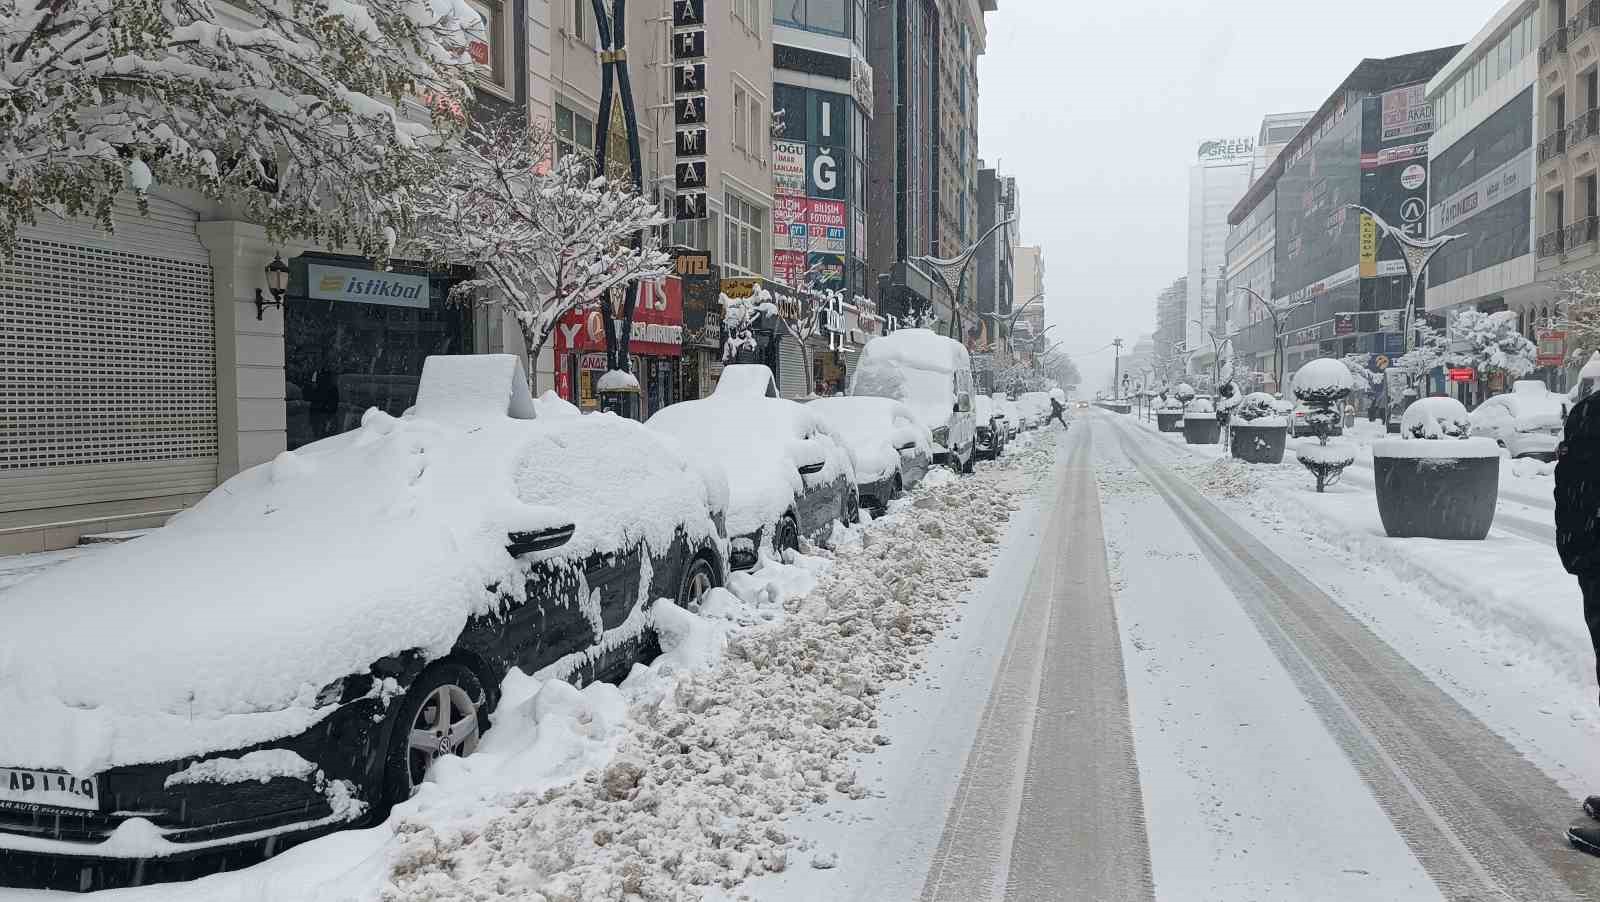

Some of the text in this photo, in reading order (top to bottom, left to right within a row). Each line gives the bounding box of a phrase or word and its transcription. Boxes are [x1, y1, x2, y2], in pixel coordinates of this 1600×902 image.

[677, 255, 709, 275] OTEL
[346, 276, 423, 300] istikbal
[13, 803, 40, 811] AUTO
